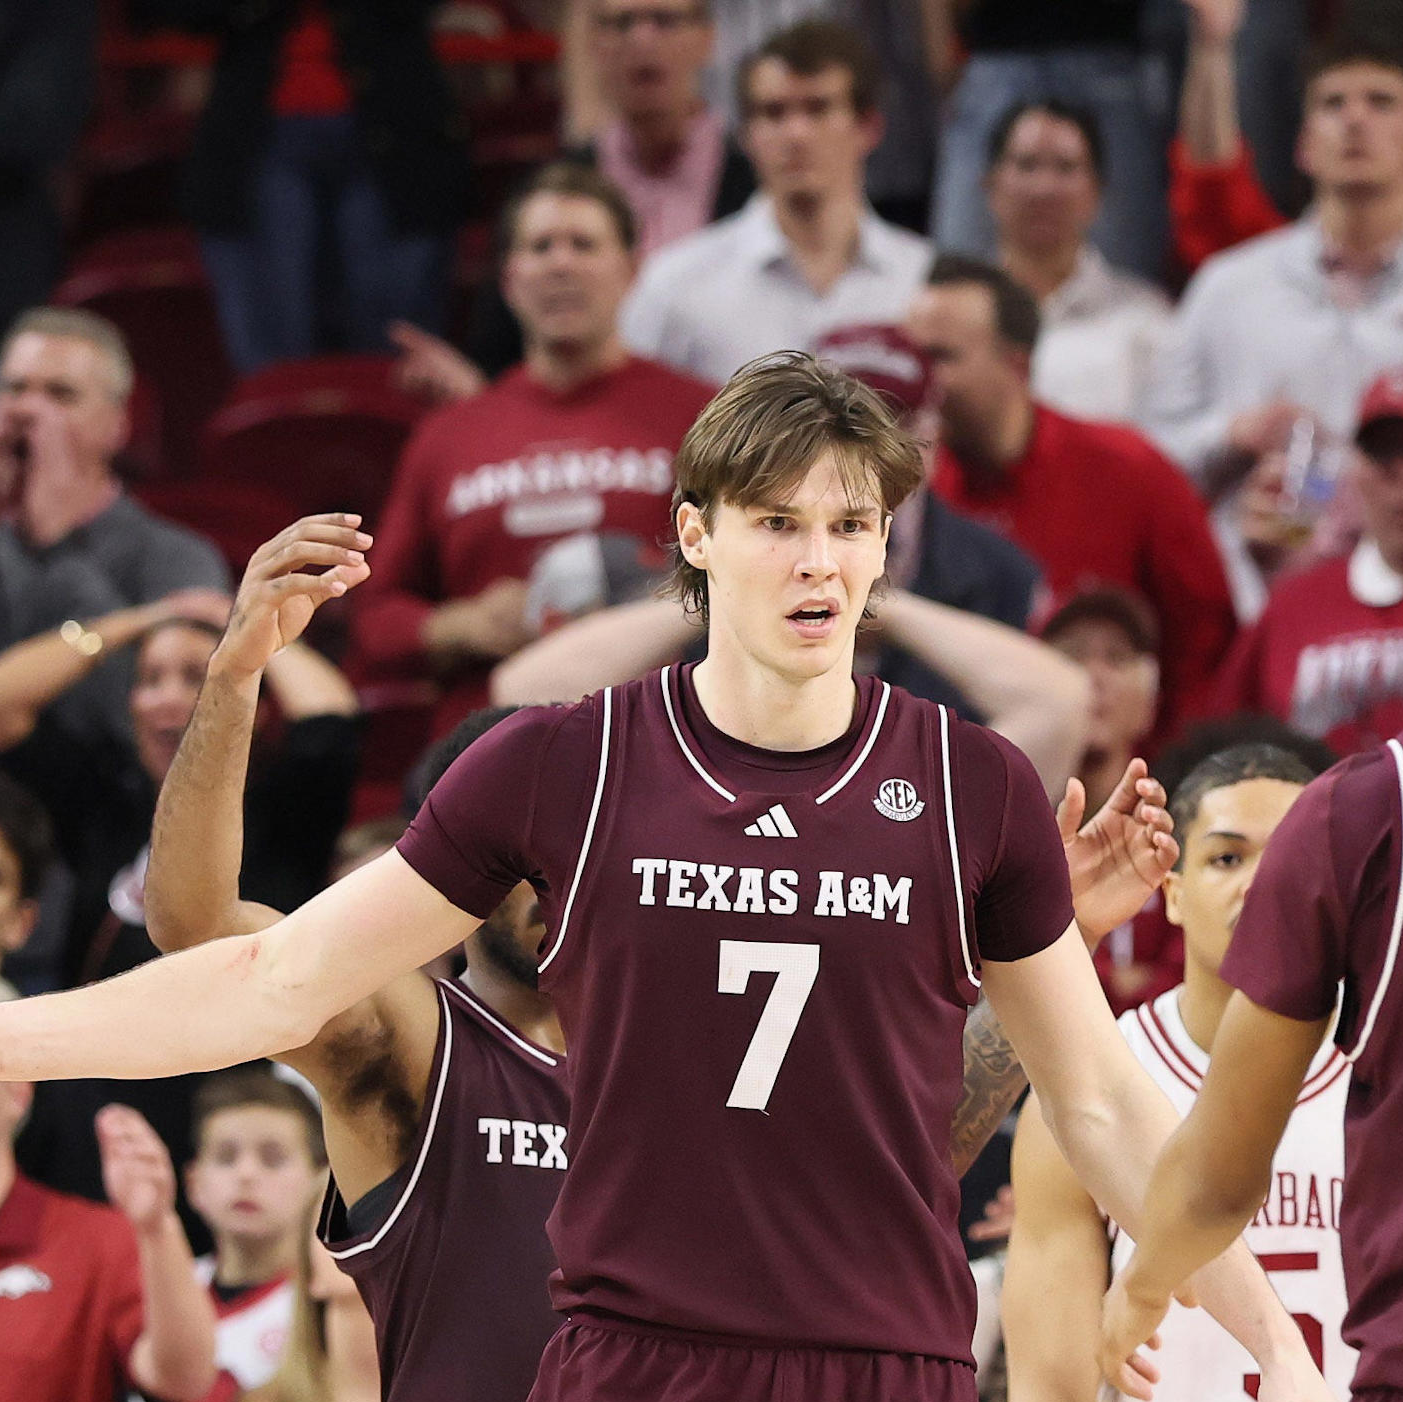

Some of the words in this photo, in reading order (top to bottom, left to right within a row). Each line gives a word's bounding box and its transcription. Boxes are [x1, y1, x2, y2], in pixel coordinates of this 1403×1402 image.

[882, 781, 913, 810] SEC
[631, 858, 799, 915] TEXAS
[813, 870, 913, 925] A&M
[717, 939, 821, 1111] 7
[478, 1117, 569, 1171] TEX
